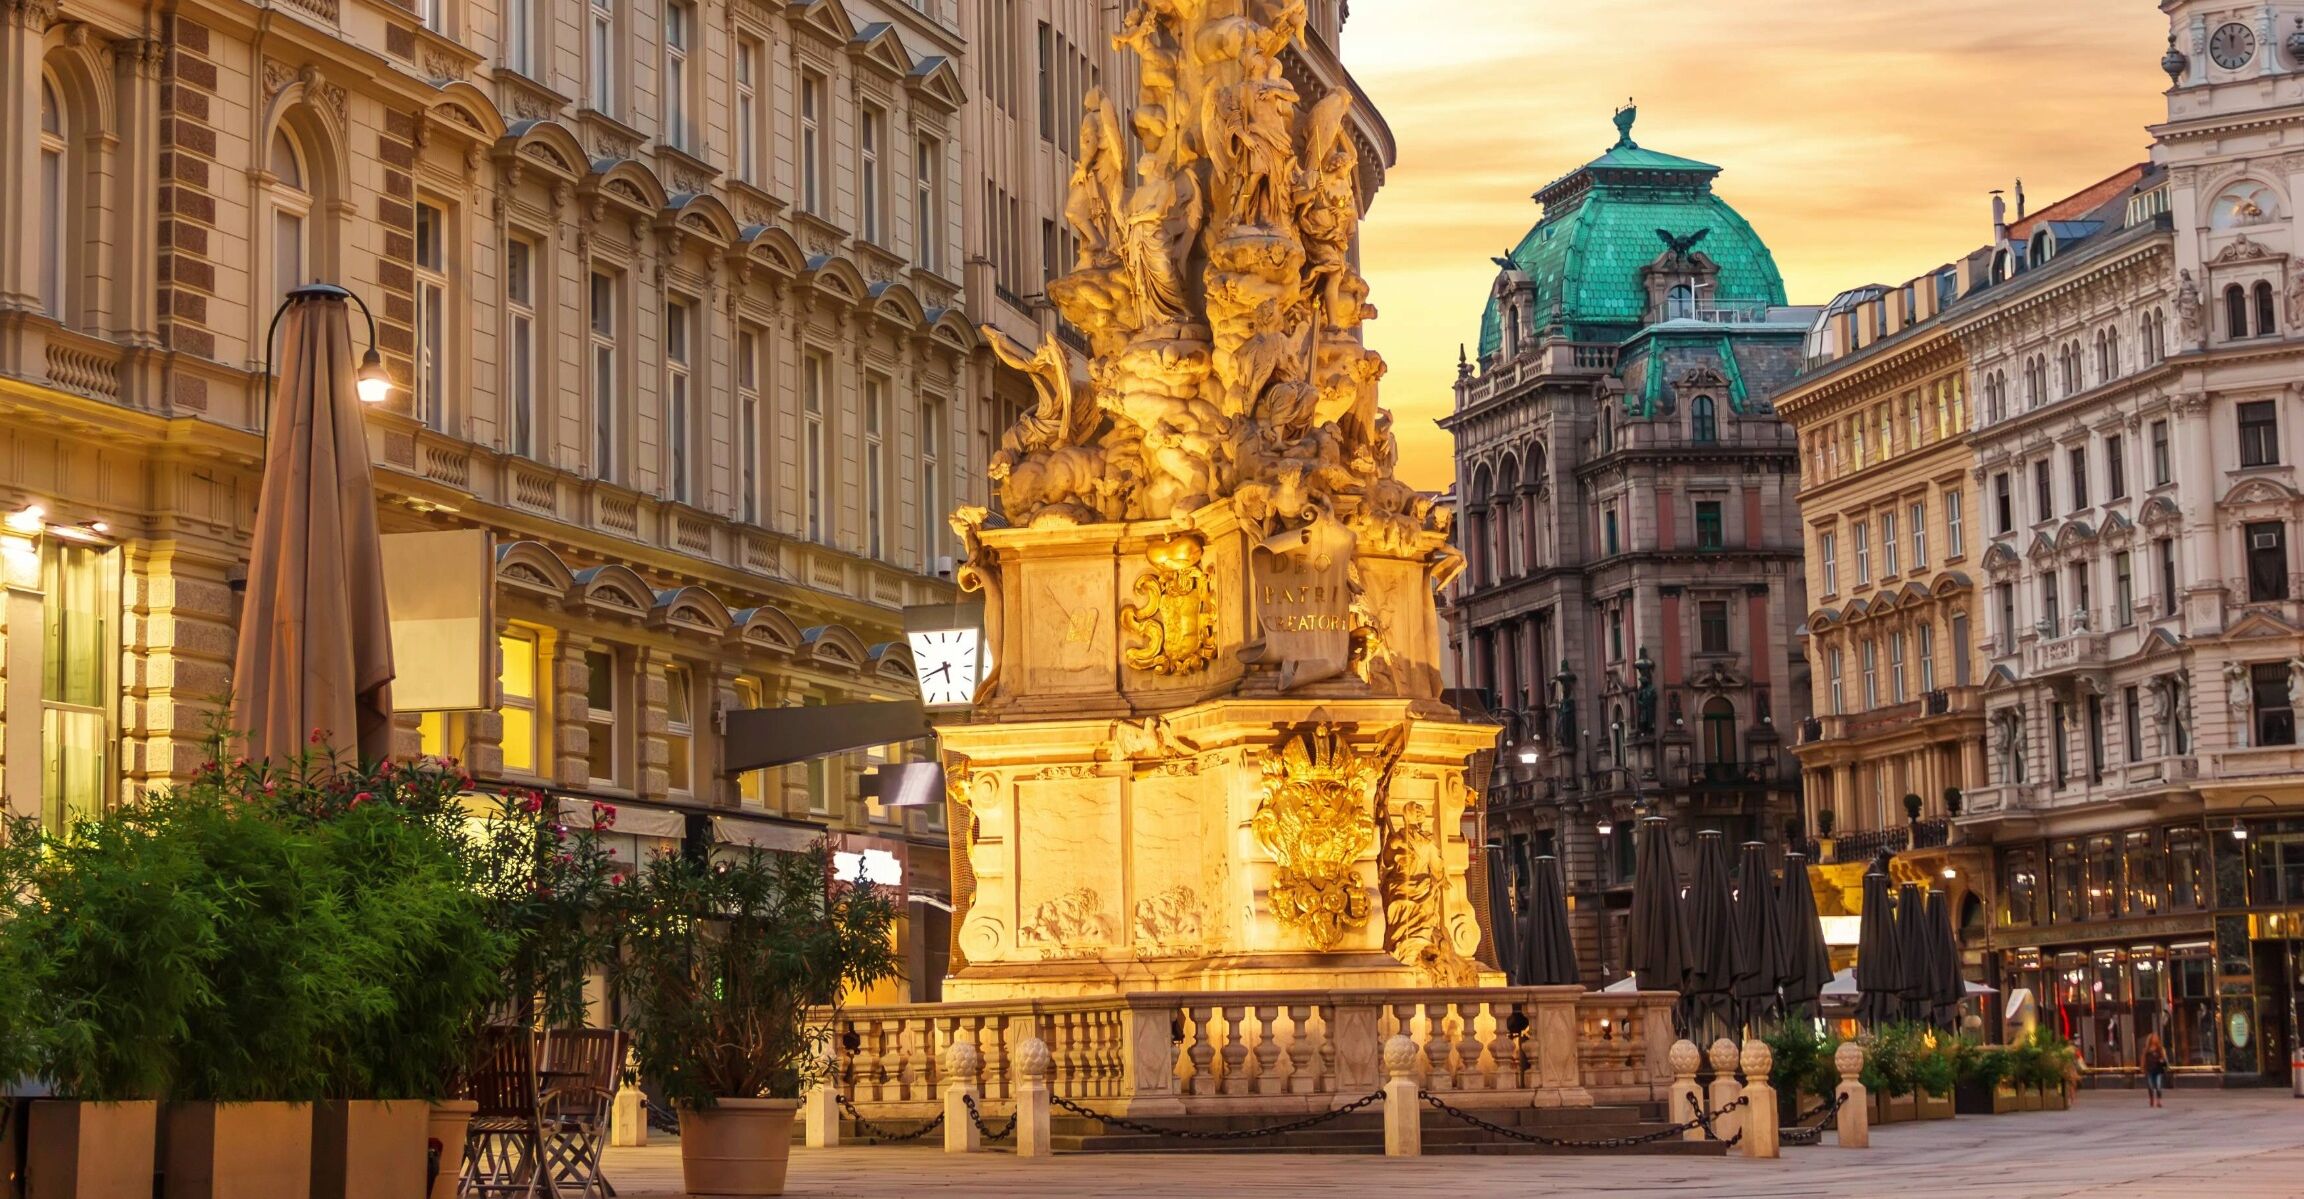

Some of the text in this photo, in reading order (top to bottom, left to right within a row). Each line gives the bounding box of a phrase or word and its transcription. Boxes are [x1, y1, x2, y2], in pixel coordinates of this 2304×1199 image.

[1270, 553, 1331, 573] DEO
[1264, 586, 1337, 604] PATRI
[1265, 615, 1346, 632] CREATORI
